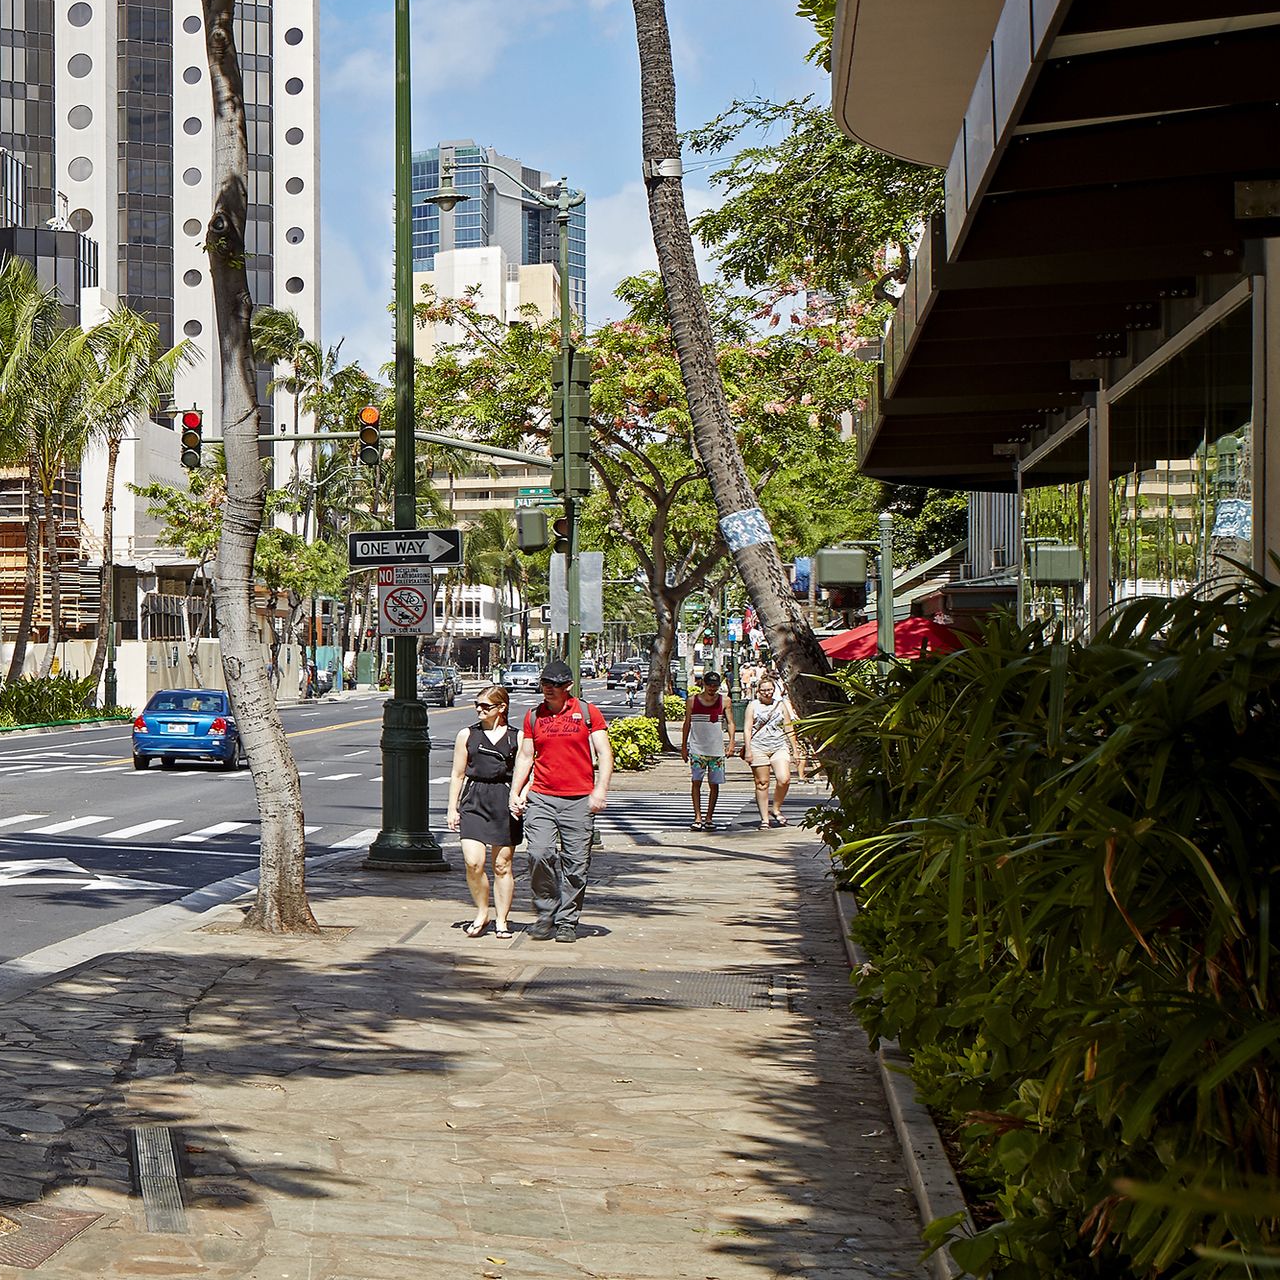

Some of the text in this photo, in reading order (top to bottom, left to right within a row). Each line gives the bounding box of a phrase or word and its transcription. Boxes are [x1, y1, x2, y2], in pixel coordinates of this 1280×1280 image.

[360, 540, 426, 556] ONE WAY
[379, 569, 393, 583] NO
